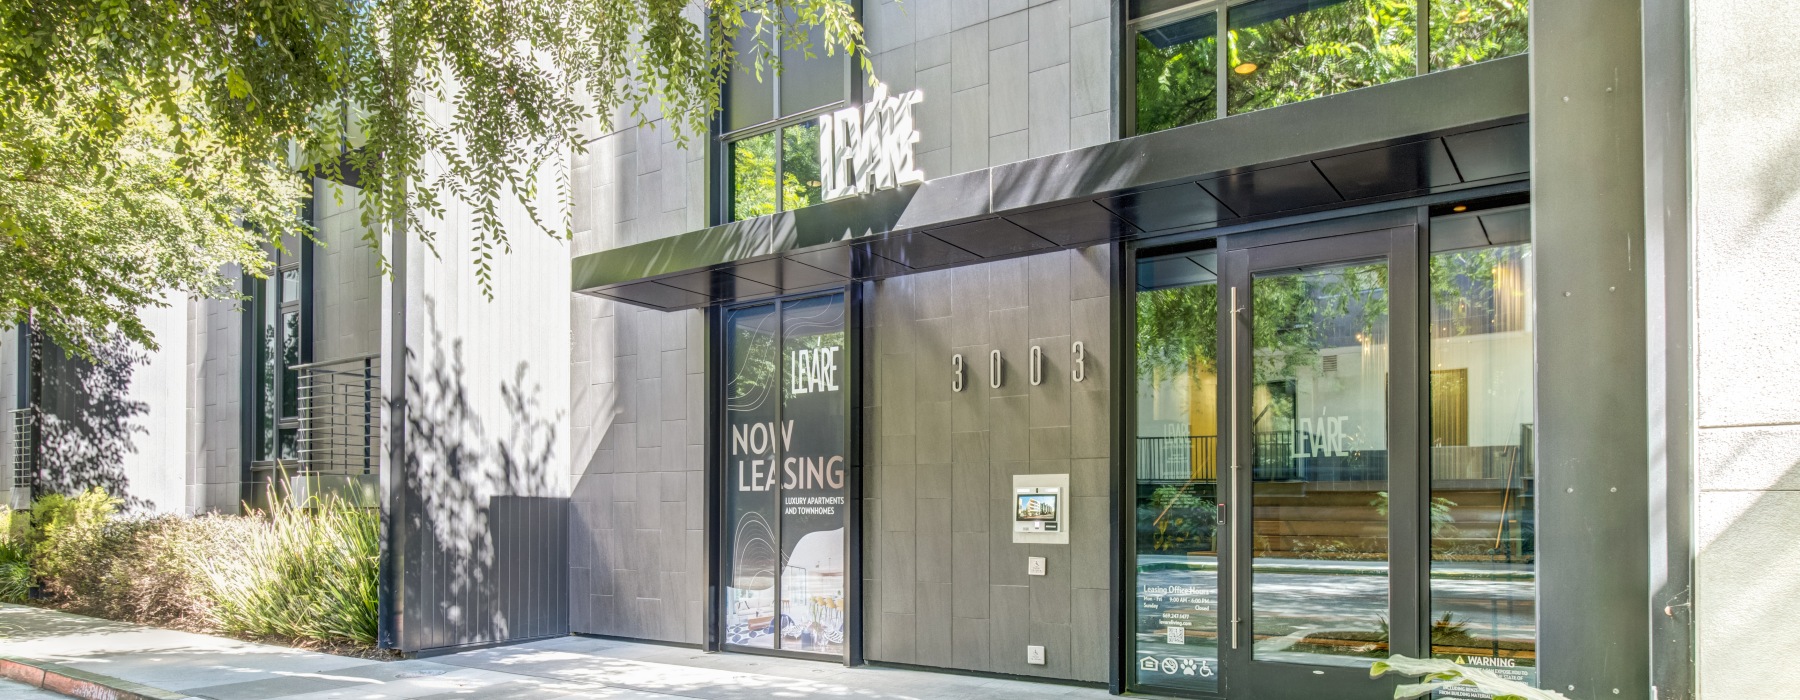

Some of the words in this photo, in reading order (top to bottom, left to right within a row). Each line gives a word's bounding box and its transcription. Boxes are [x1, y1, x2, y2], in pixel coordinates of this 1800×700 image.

[732, 420, 794, 456] NOW
[739, 456, 844, 492] LEASING
[785, 496, 807, 505] LUXURY
[807, 496, 845, 505] APARTMENTS
[785, 506, 798, 515] AND
[798, 506, 835, 515] TOWNHOMES
[1144, 585, 1168, 595] Leasing
[1168, 585, 1190, 595] Office
[1190, 586, 1210, 596] Hours
[1467, 655, 1516, 668] WARNING
